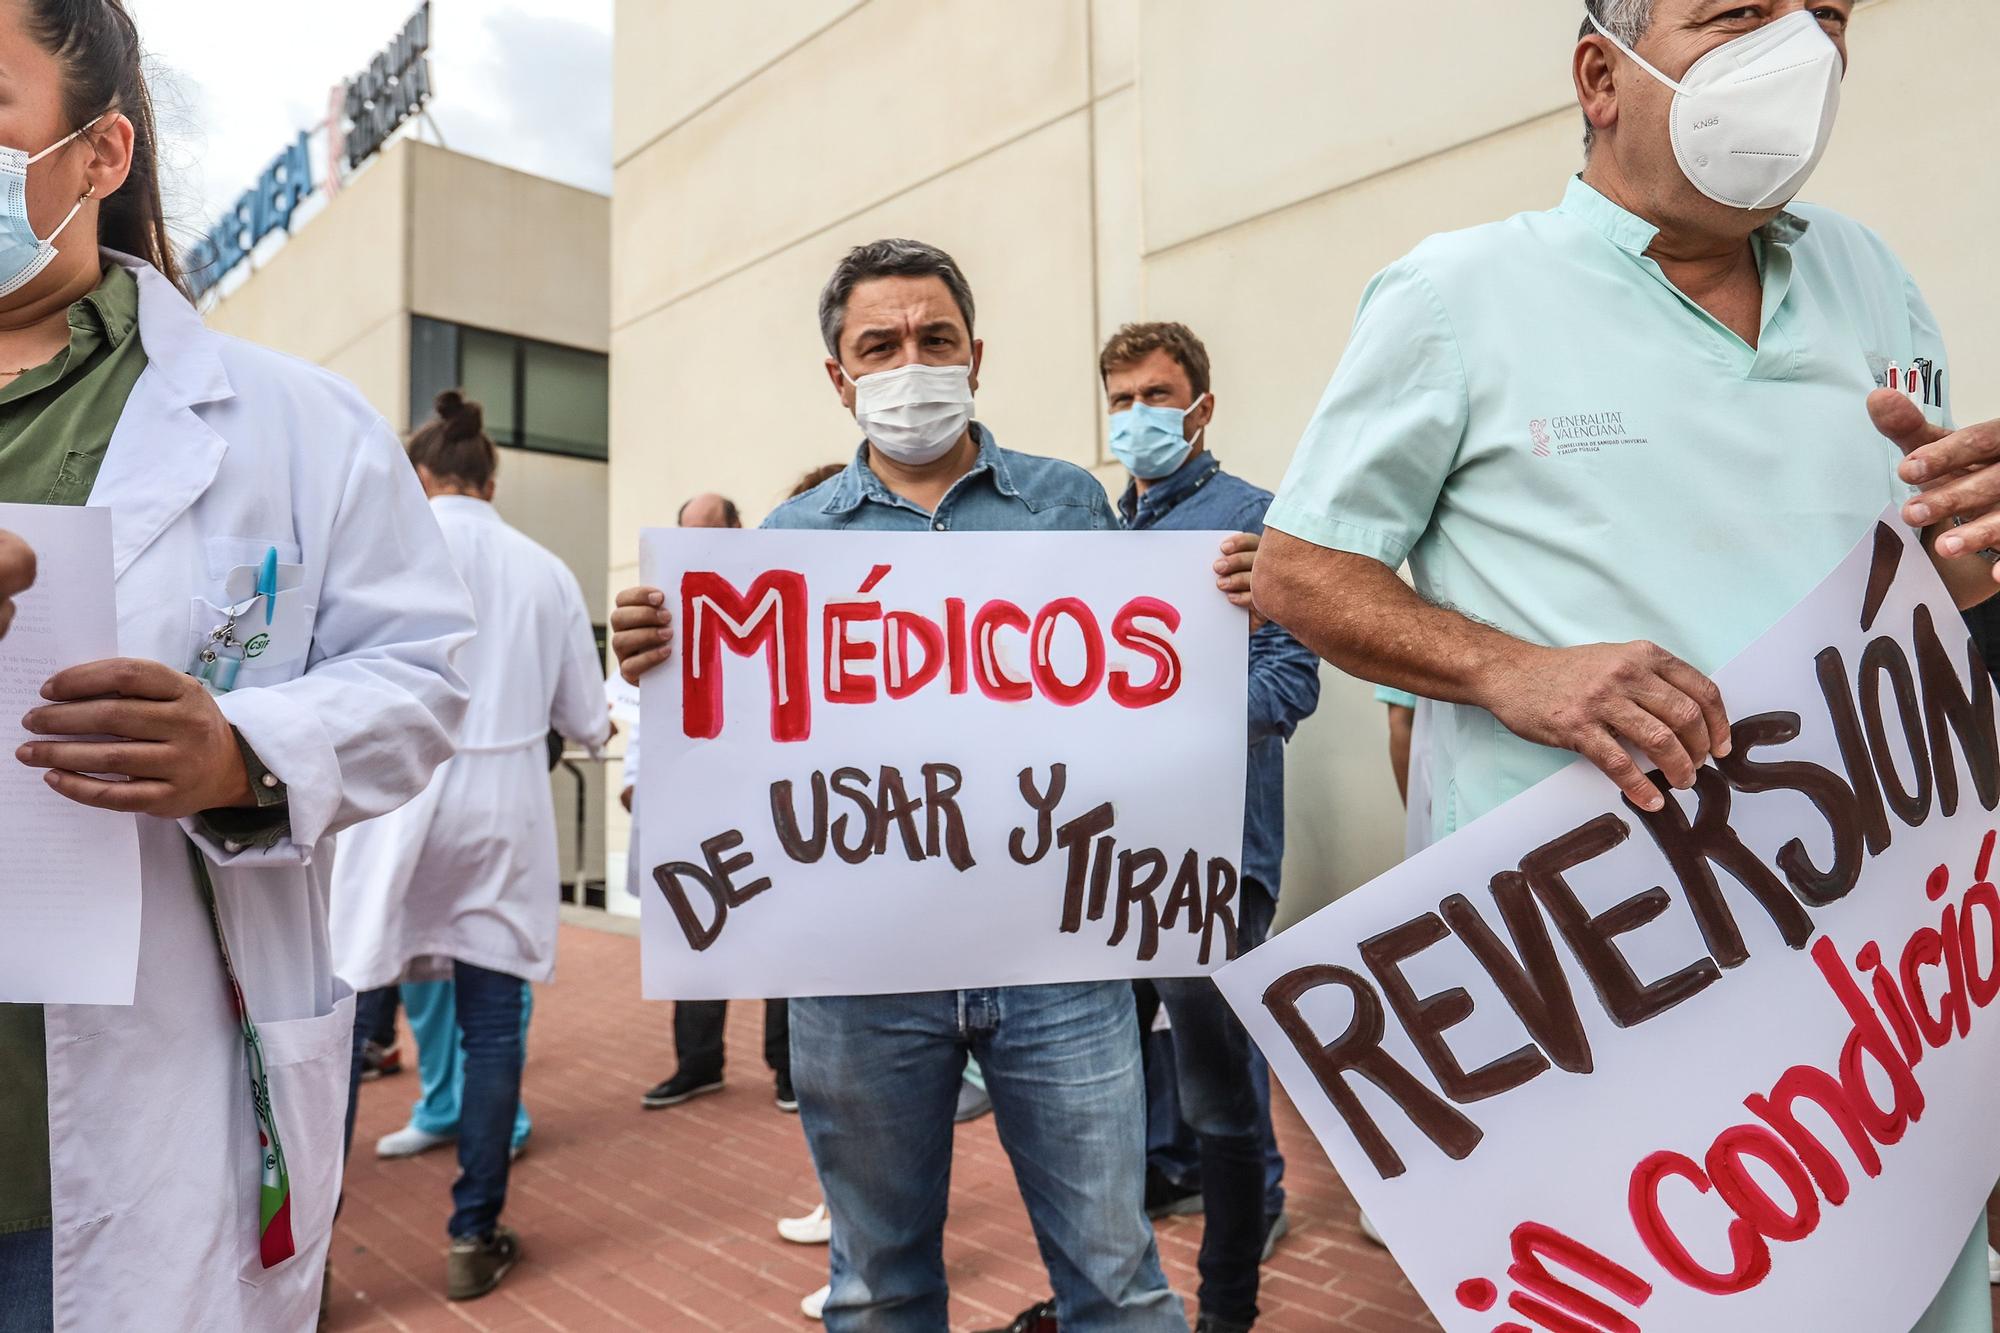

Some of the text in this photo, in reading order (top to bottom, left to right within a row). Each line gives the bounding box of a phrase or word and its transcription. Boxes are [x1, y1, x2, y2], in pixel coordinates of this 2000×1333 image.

[1693, 116, 1719, 131] KN95
[1551, 411, 1624, 429] GENERALITAT
[1553, 424, 1626, 440] VALENCIANA
[1620, 437, 1649, 445] UNIVERSAL
[1562, 447, 1578, 455] SALUD
[681, 564, 1183, 743] MÉDICOS
[1262, 520, 2000, 1180] REVERSIÓN
[653, 762, 1239, 965] DE USAR Y TIRAR
[1456, 1219, 1653, 1333] in
